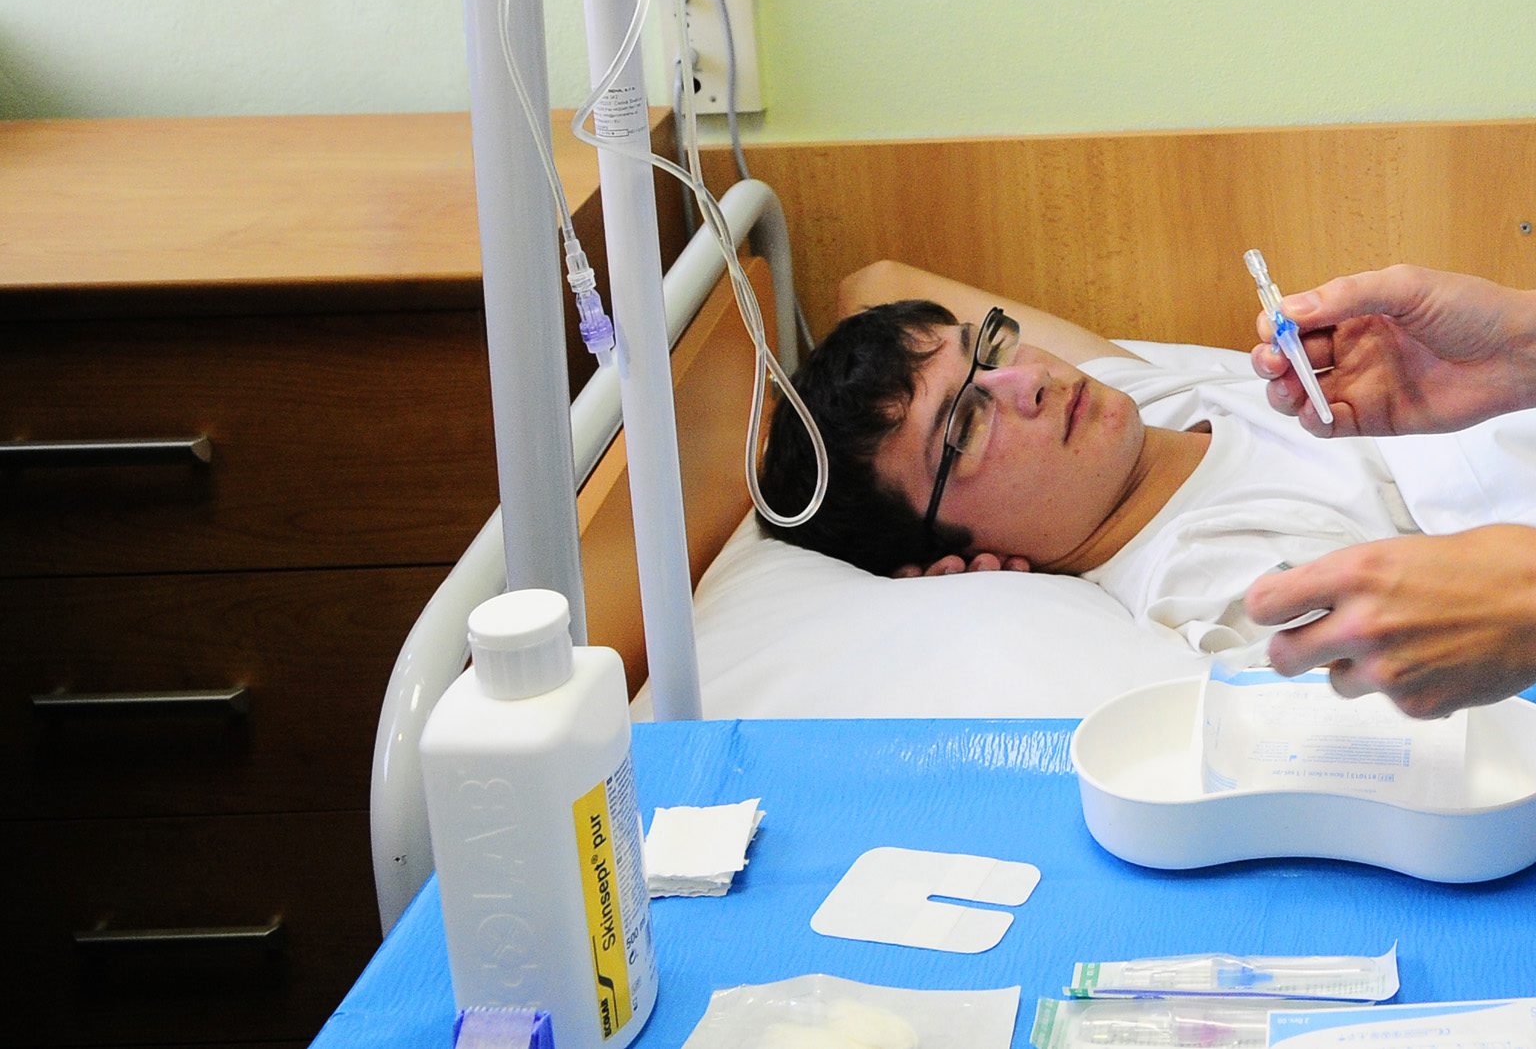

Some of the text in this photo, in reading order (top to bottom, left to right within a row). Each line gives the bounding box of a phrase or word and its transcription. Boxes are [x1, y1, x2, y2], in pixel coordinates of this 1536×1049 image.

[589, 813, 606, 849] pur
[626, 926, 639, 950] 500
[600, 998, 612, 1038] ECOLAB
